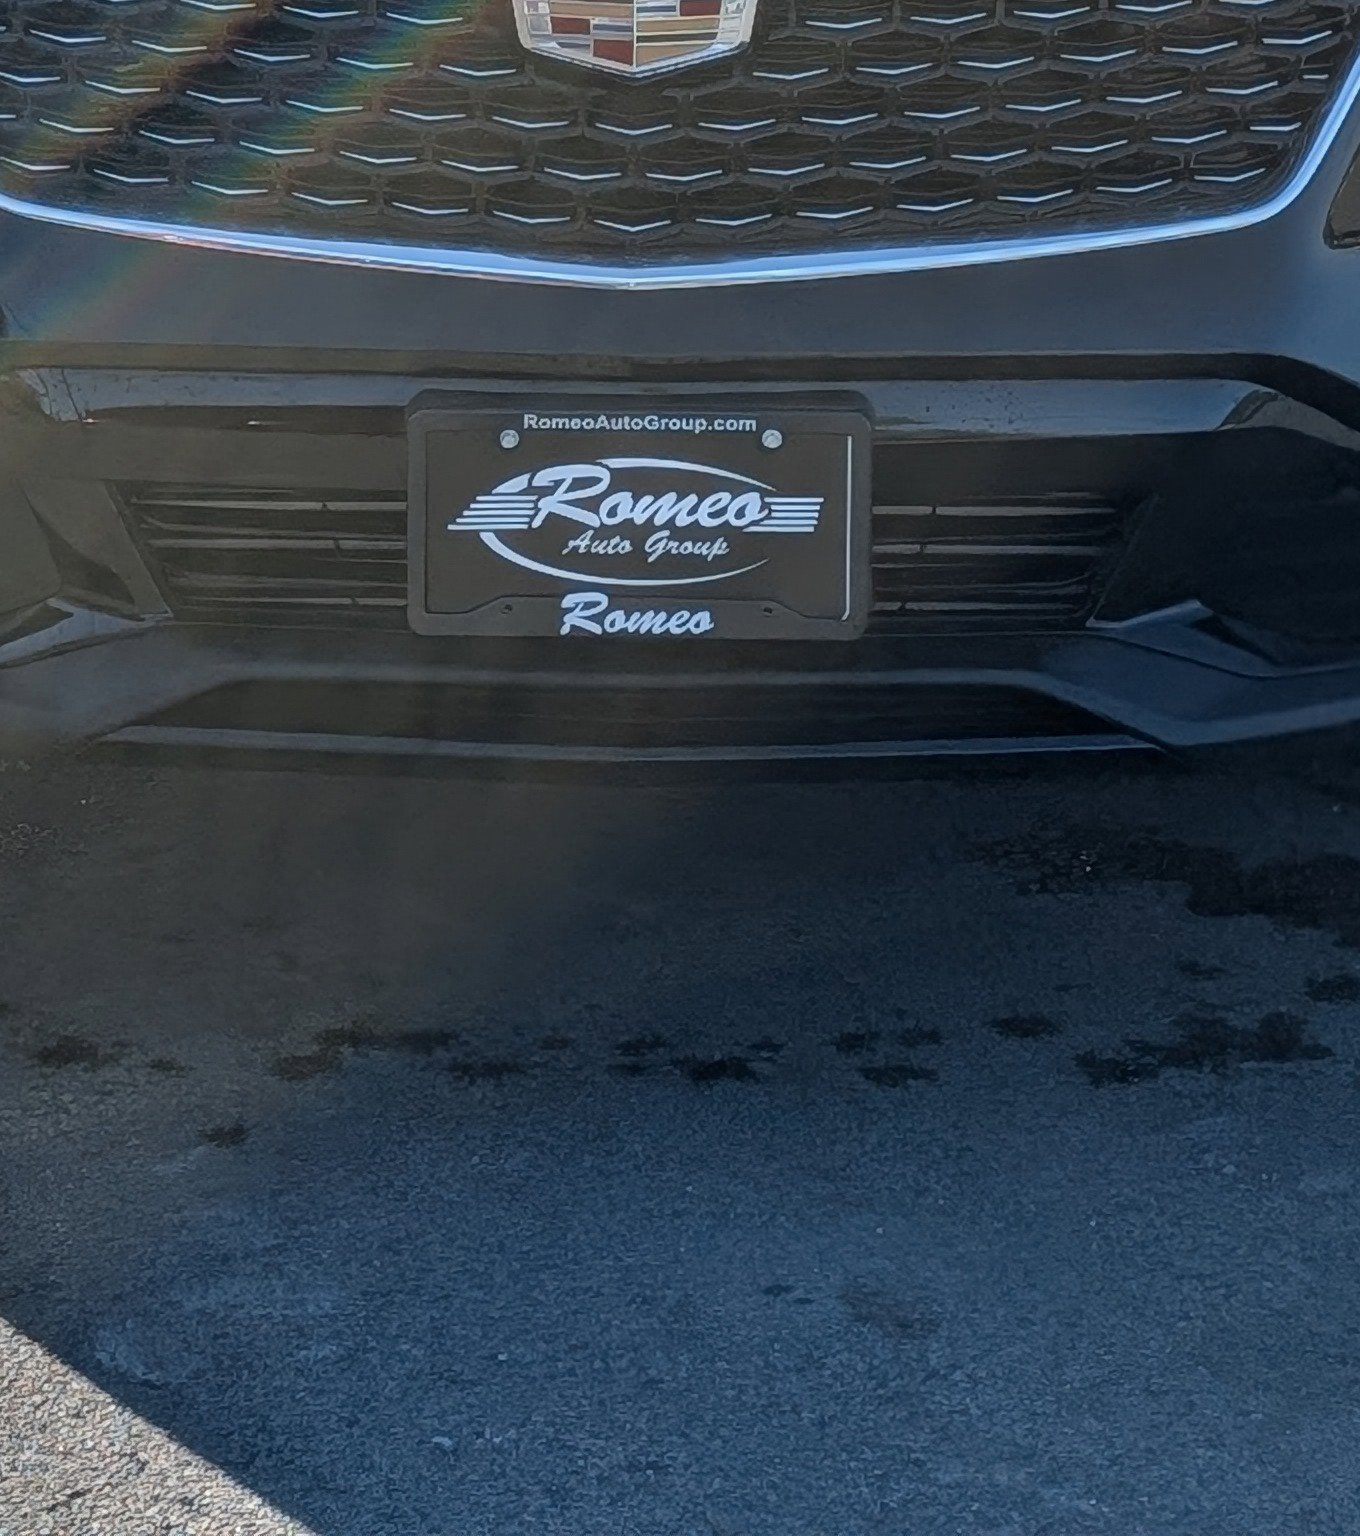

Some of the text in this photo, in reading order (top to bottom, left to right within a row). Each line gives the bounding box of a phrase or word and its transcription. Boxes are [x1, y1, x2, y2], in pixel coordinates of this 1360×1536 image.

[523, 413, 757, 434] RomeoAutoGroup.com
[530, 463, 770, 529] Romeo
[561, 529, 730, 563] Auto Group
[559, 591, 715, 636] Romeo
